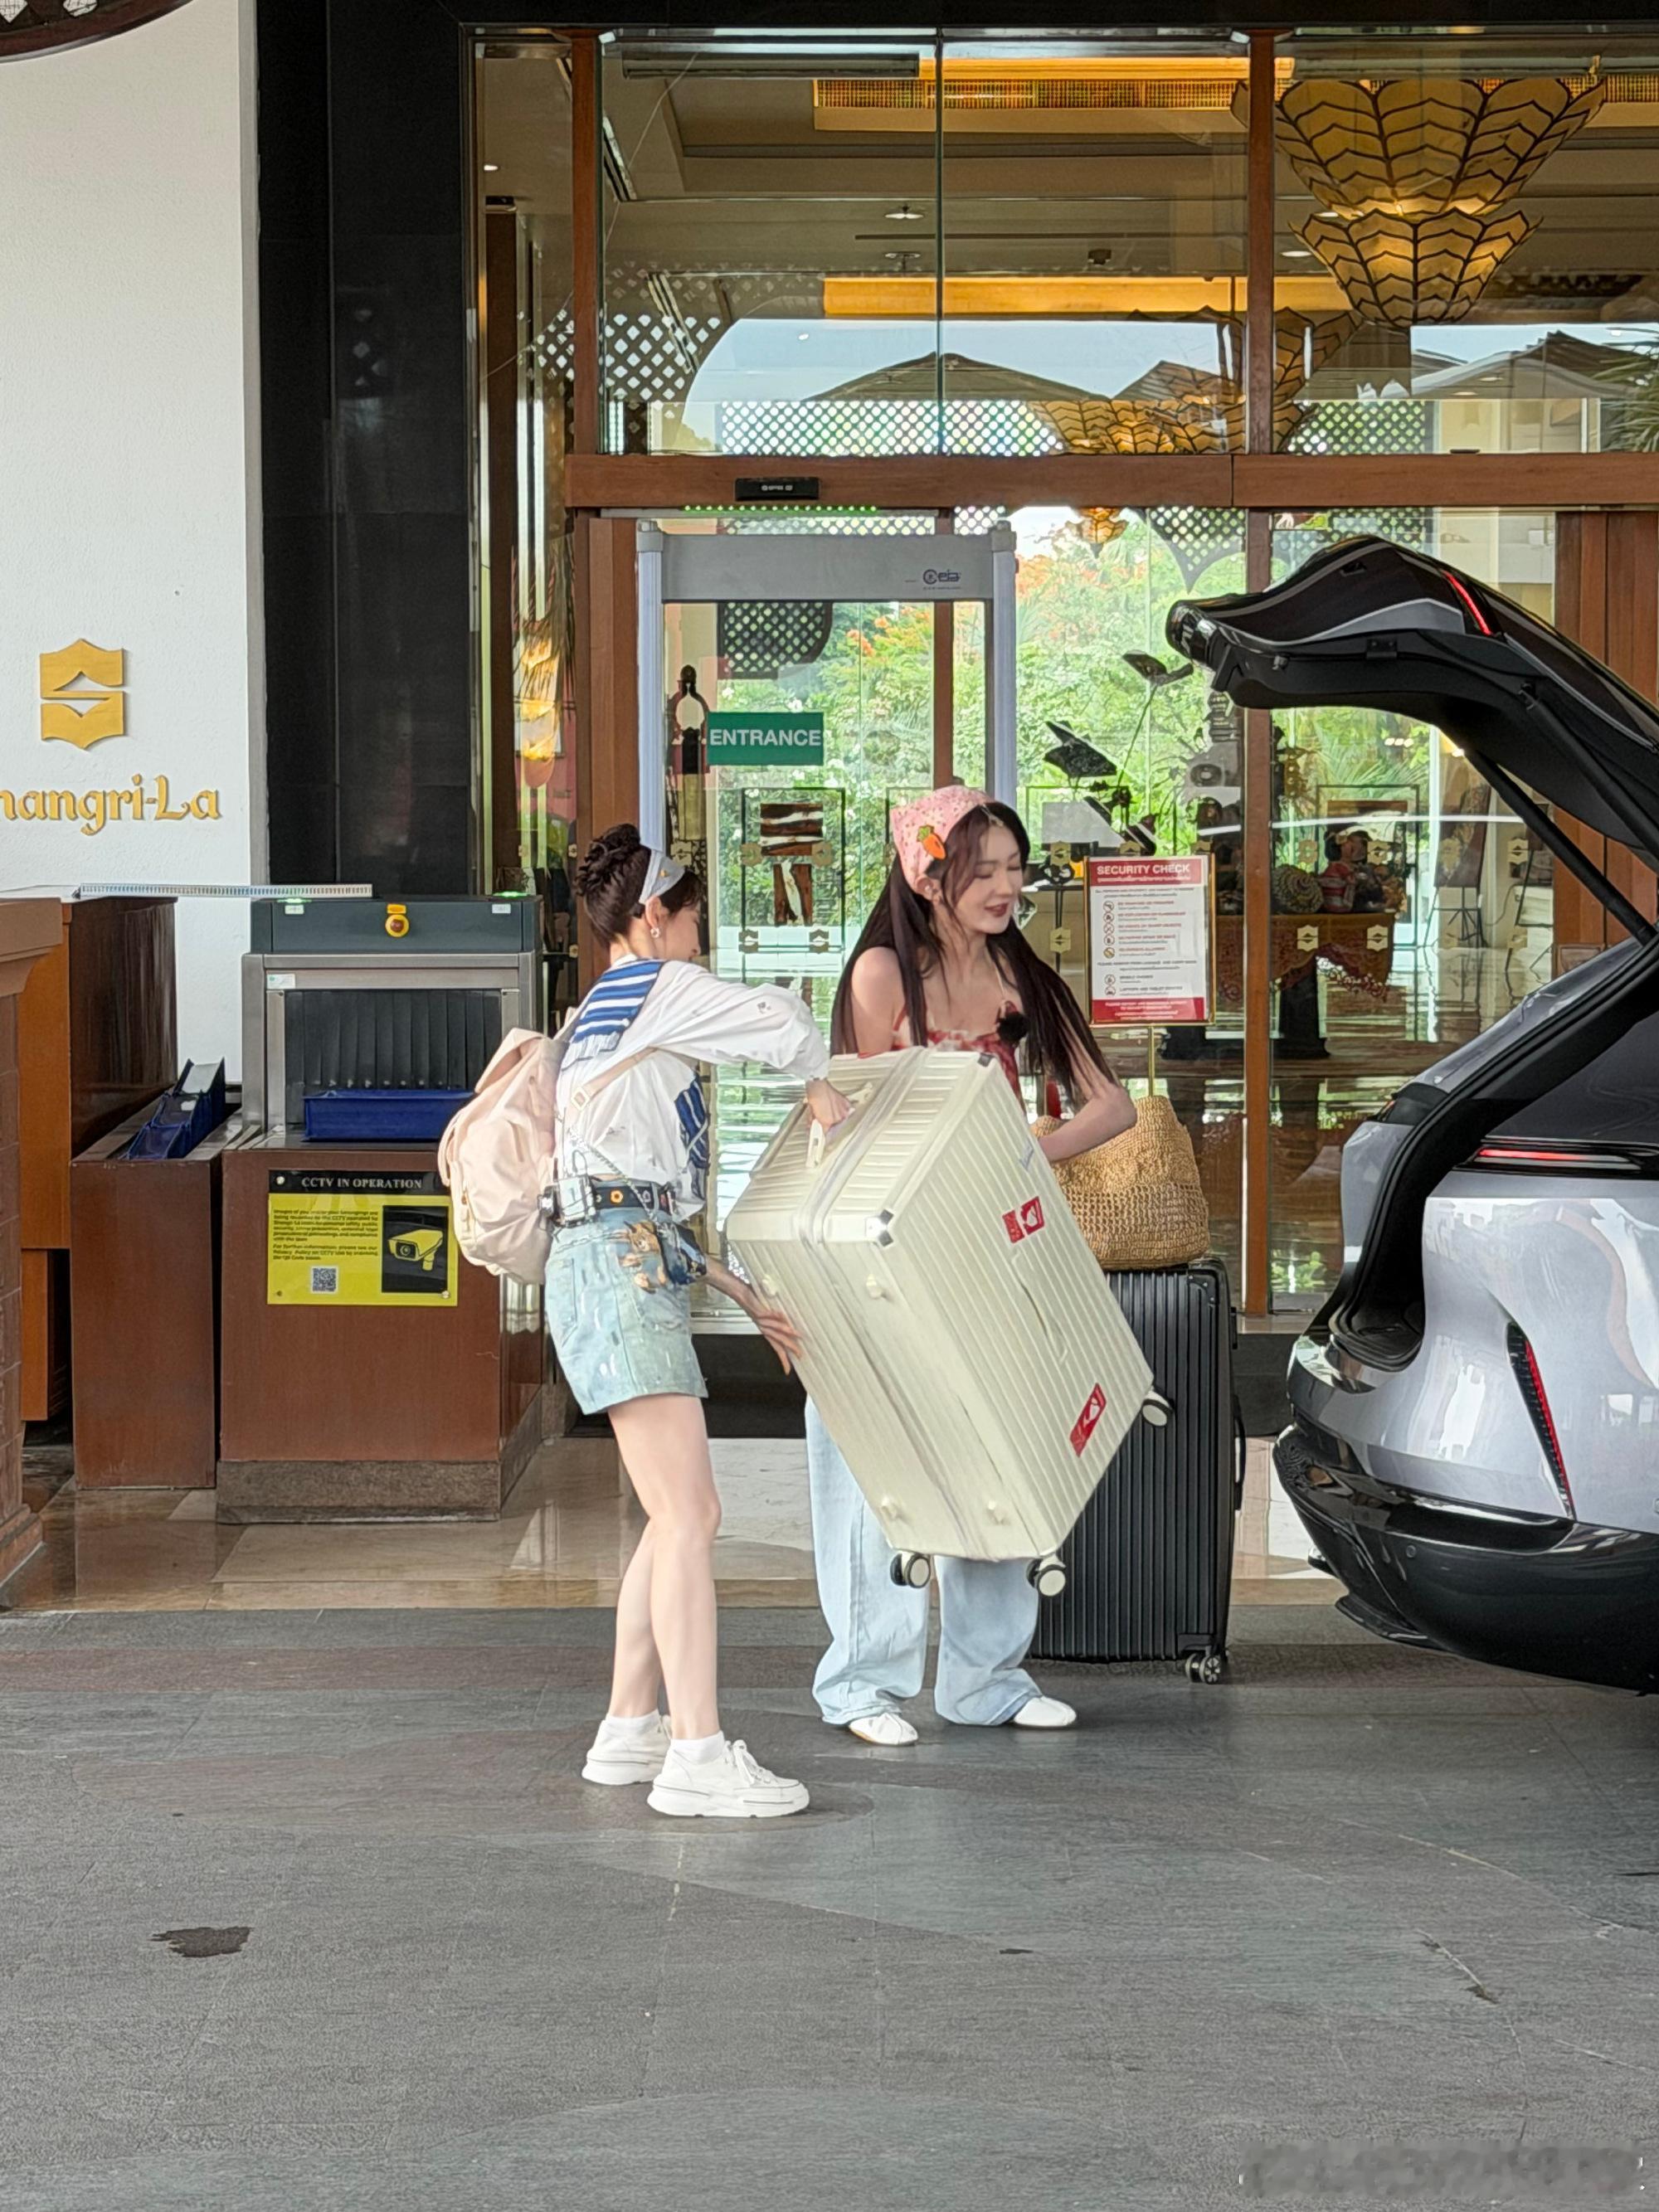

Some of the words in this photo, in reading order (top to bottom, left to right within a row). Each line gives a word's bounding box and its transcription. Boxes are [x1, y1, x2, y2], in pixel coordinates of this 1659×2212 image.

[709, 728, 822, 746] ENTRANCE
[1097, 864, 1151, 875] SECURITY
[1152, 863, 1190, 873] CHECK
[301, 1177, 334, 1188] CCTV
[338, 1178, 349, 1188] IN
[353, 1178, 422, 1189] OPERATION
